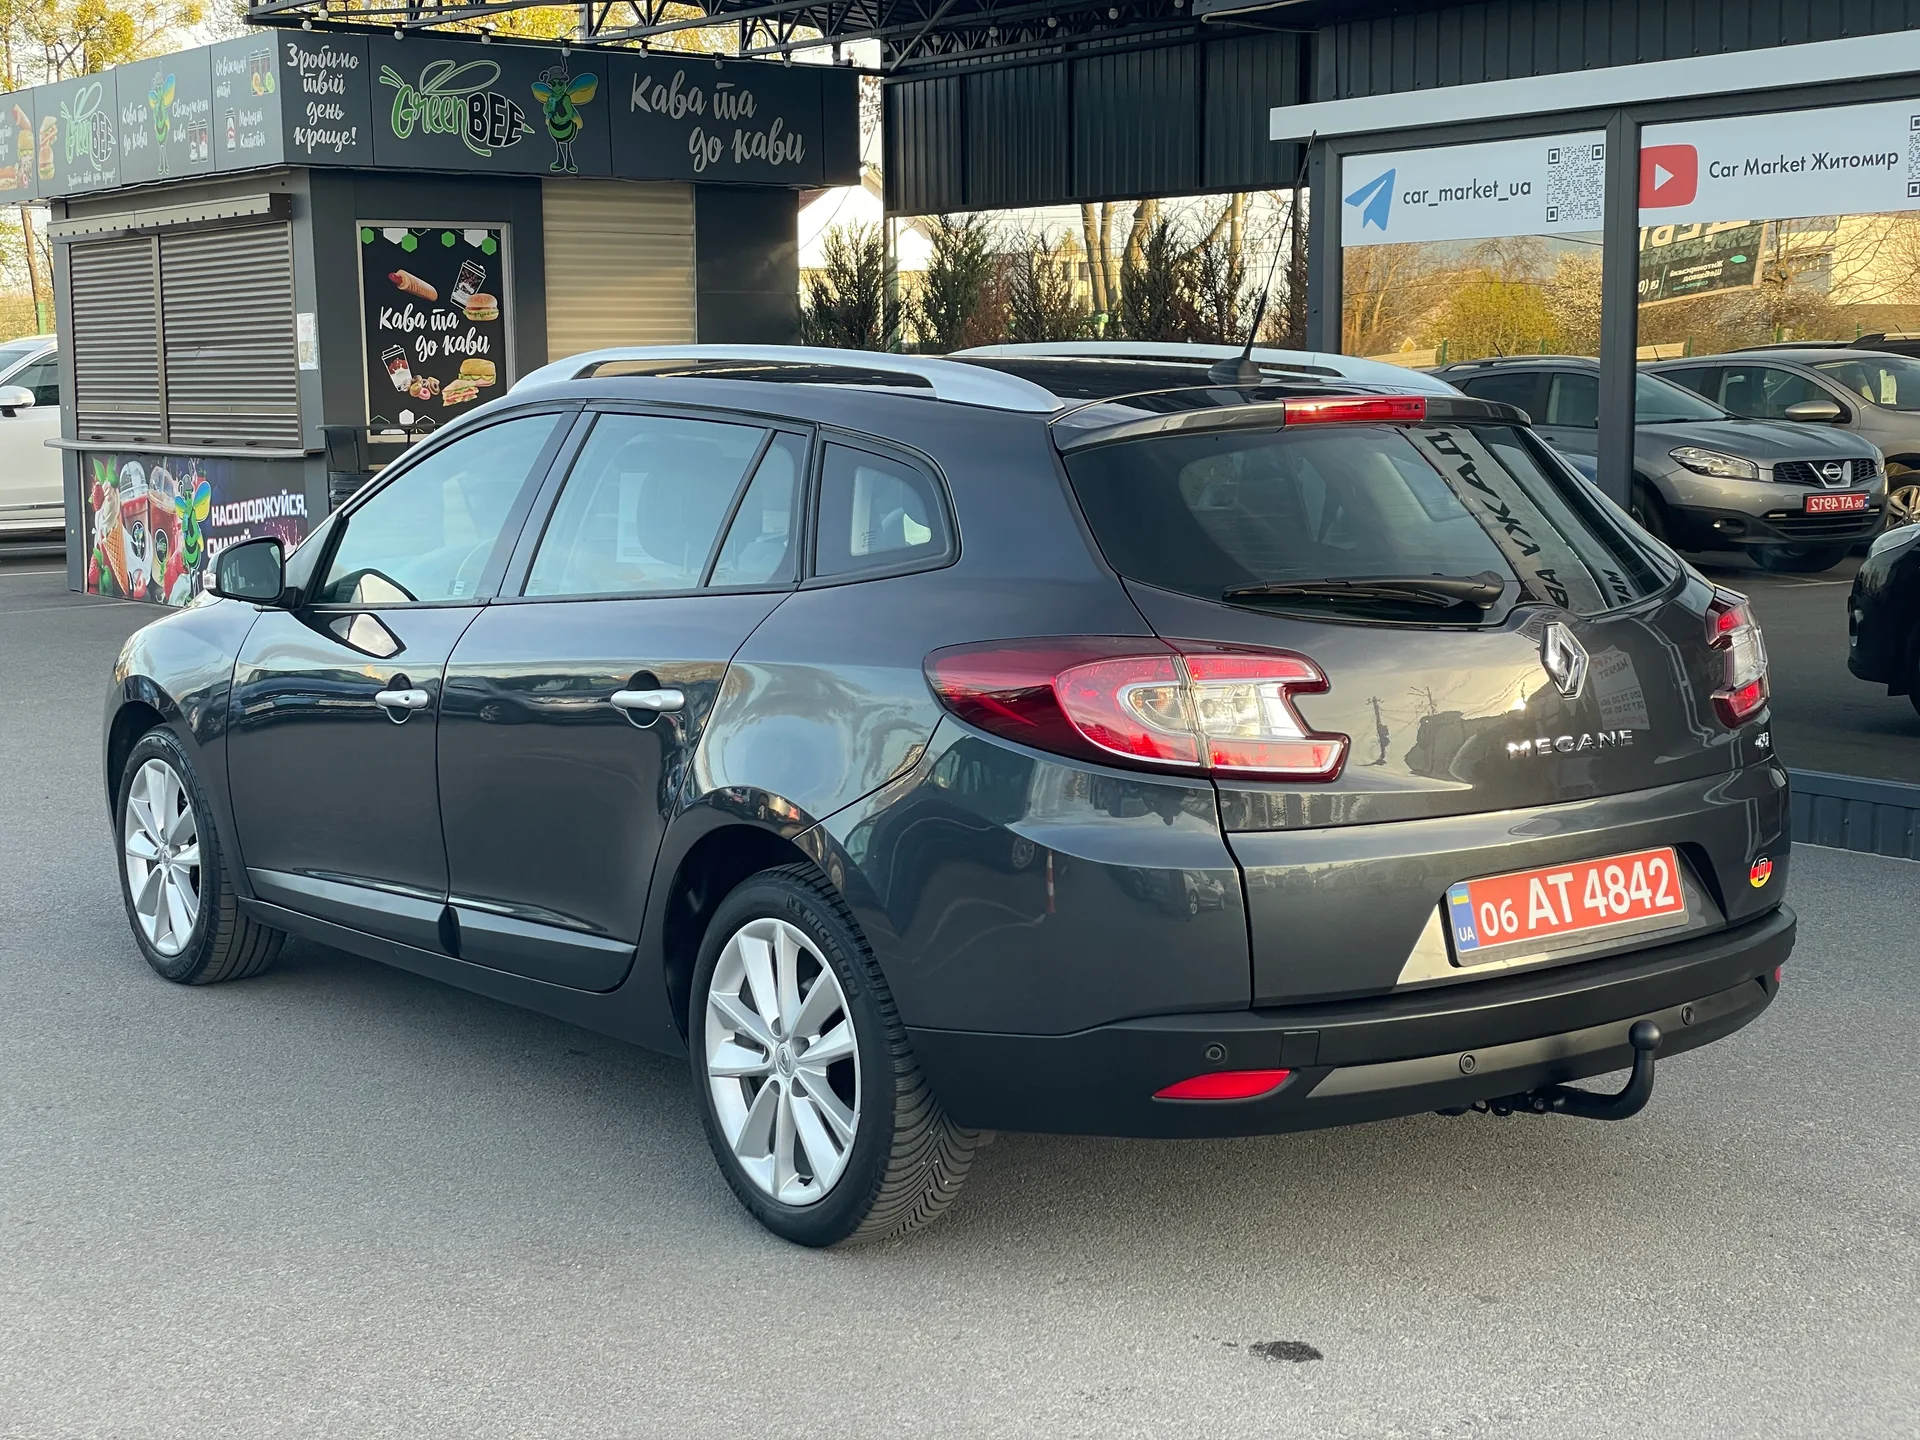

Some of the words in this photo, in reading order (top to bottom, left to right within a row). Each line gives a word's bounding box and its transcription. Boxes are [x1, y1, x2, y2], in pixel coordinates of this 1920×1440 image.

[286, 43, 359, 76] Зробимо
[303, 69, 347, 96] твій
[631, 70, 706, 119] Кава
[713, 82, 757, 121] та
[306, 102, 346, 126] день
[391, 84, 525, 157] GreenBEE
[293, 126, 357, 155] краще!
[689, 128, 725, 173] до
[731, 117, 806, 165] кави
[1709, 160, 1738, 180] Car
[1744, 155, 1806, 176] Market
[1811, 150, 1899, 171] Житомир
[1403, 179, 1532, 208] car_market_ua
[379, 303, 427, 332] Кава
[430, 308, 459, 331] та
[415, 334, 438, 362] до
[442, 327, 491, 356] кави
[211, 489, 308, 526] НАСОЛОДЖУЙСЯ,
[1506, 729, 1634, 759] MEGANE
[1480, 898, 1519, 938] 06
[1527, 872, 1574, 930] AT
[1584, 857, 1675, 918] 4842
[1458, 926, 1476, 942] UA
[802, 908, 861, 996] MICHELIN
